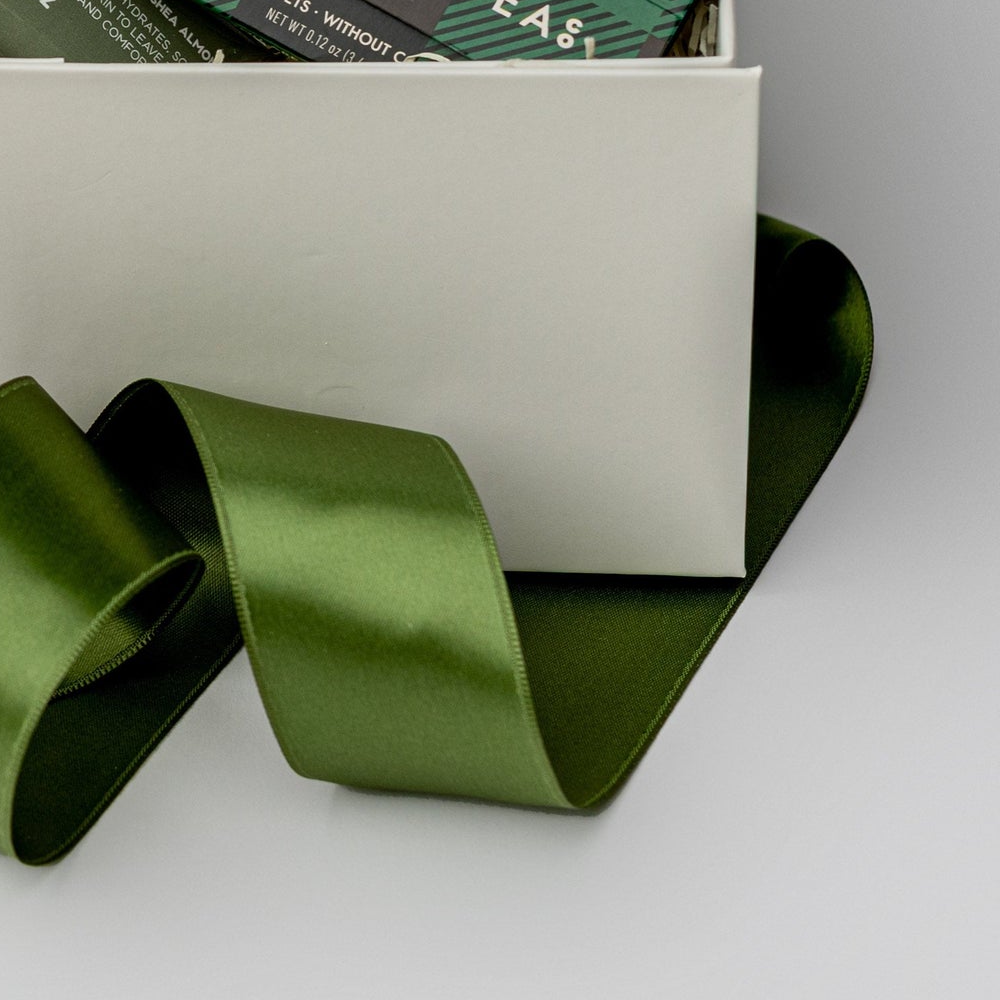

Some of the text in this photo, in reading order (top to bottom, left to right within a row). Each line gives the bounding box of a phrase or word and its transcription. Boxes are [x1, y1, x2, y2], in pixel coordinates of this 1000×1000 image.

[117, 10, 131, 29] TO
[130, 26, 164, 63] LEAVE
[178, 27, 214, 63] ALMO
[265, 7, 290, 28] NET
[288, 16, 308, 38] WT
[305, 27, 330, 49] 0.12
[327, 44, 343, 58] oz
[323, 10, 393, 56] WITHOUT
